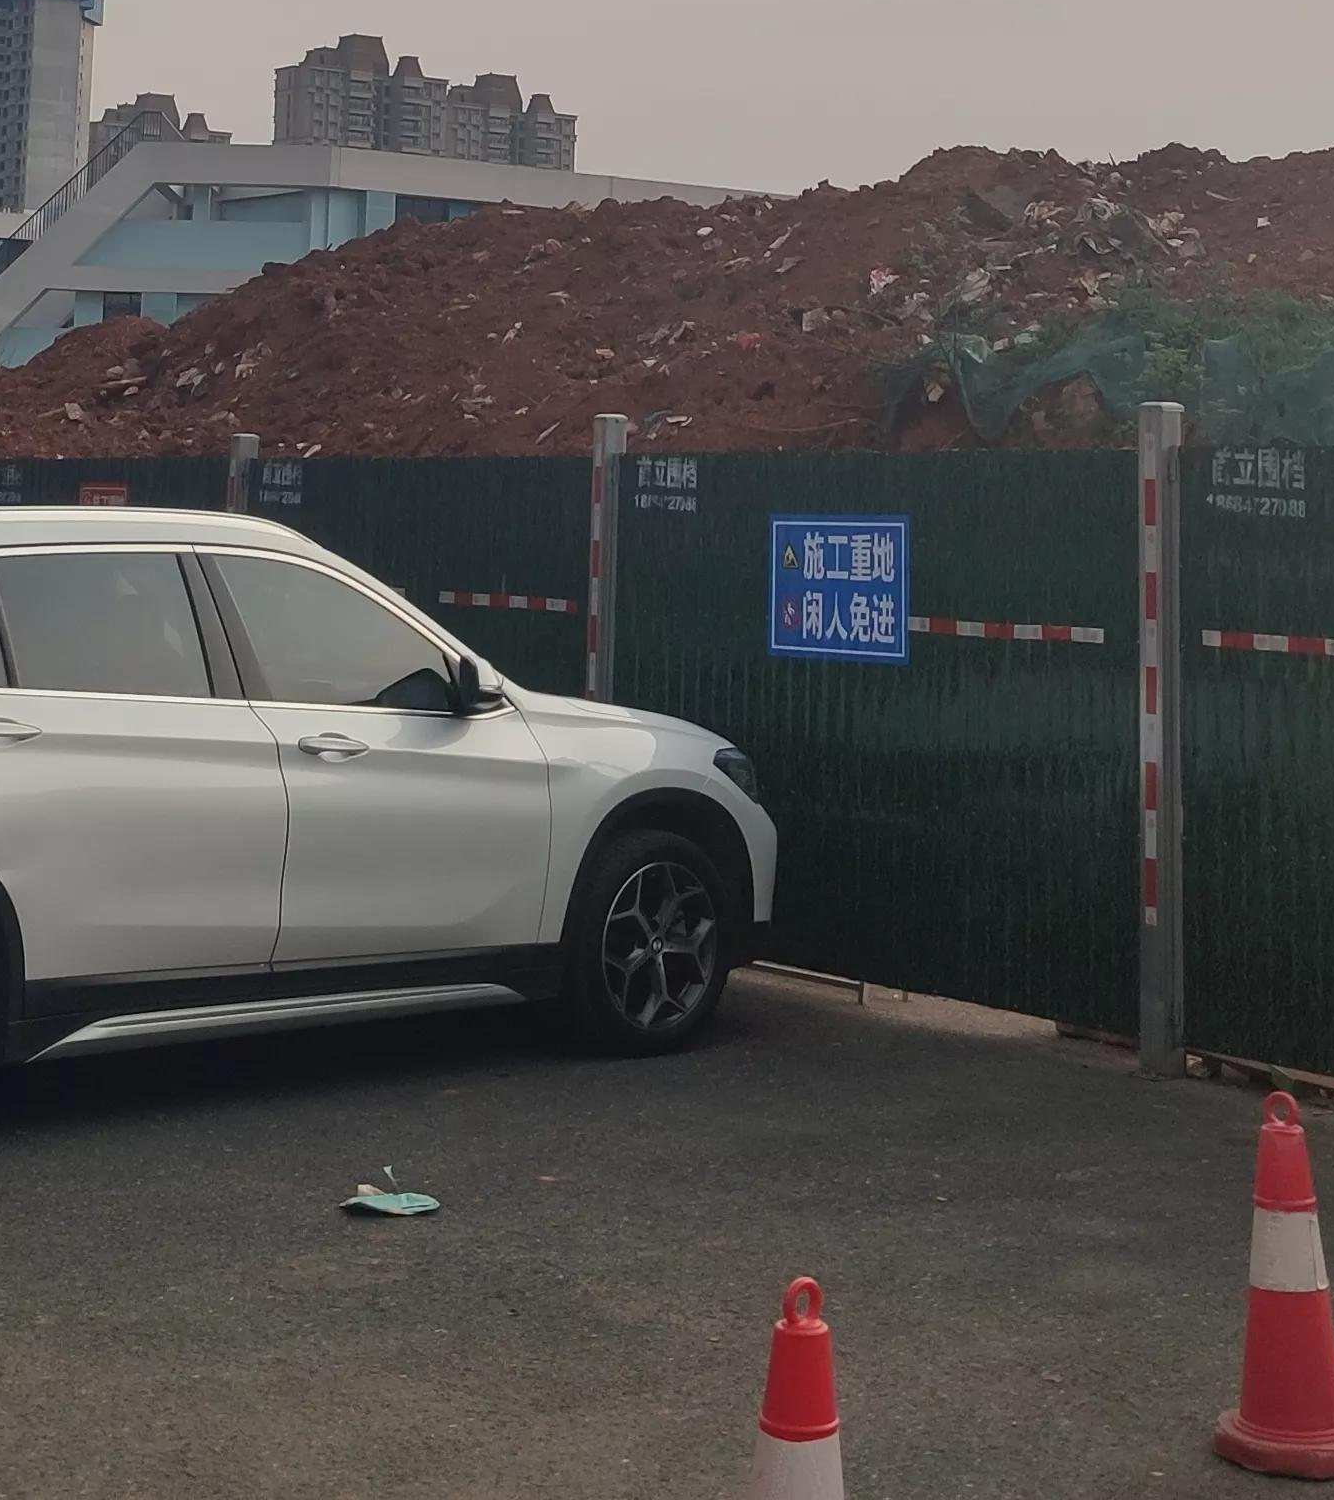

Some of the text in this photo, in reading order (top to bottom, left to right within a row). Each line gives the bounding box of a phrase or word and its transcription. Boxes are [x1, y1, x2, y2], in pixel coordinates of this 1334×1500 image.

[803, 531, 895, 583] 施工重地
[802, 590, 895, 643] 闲人免进
